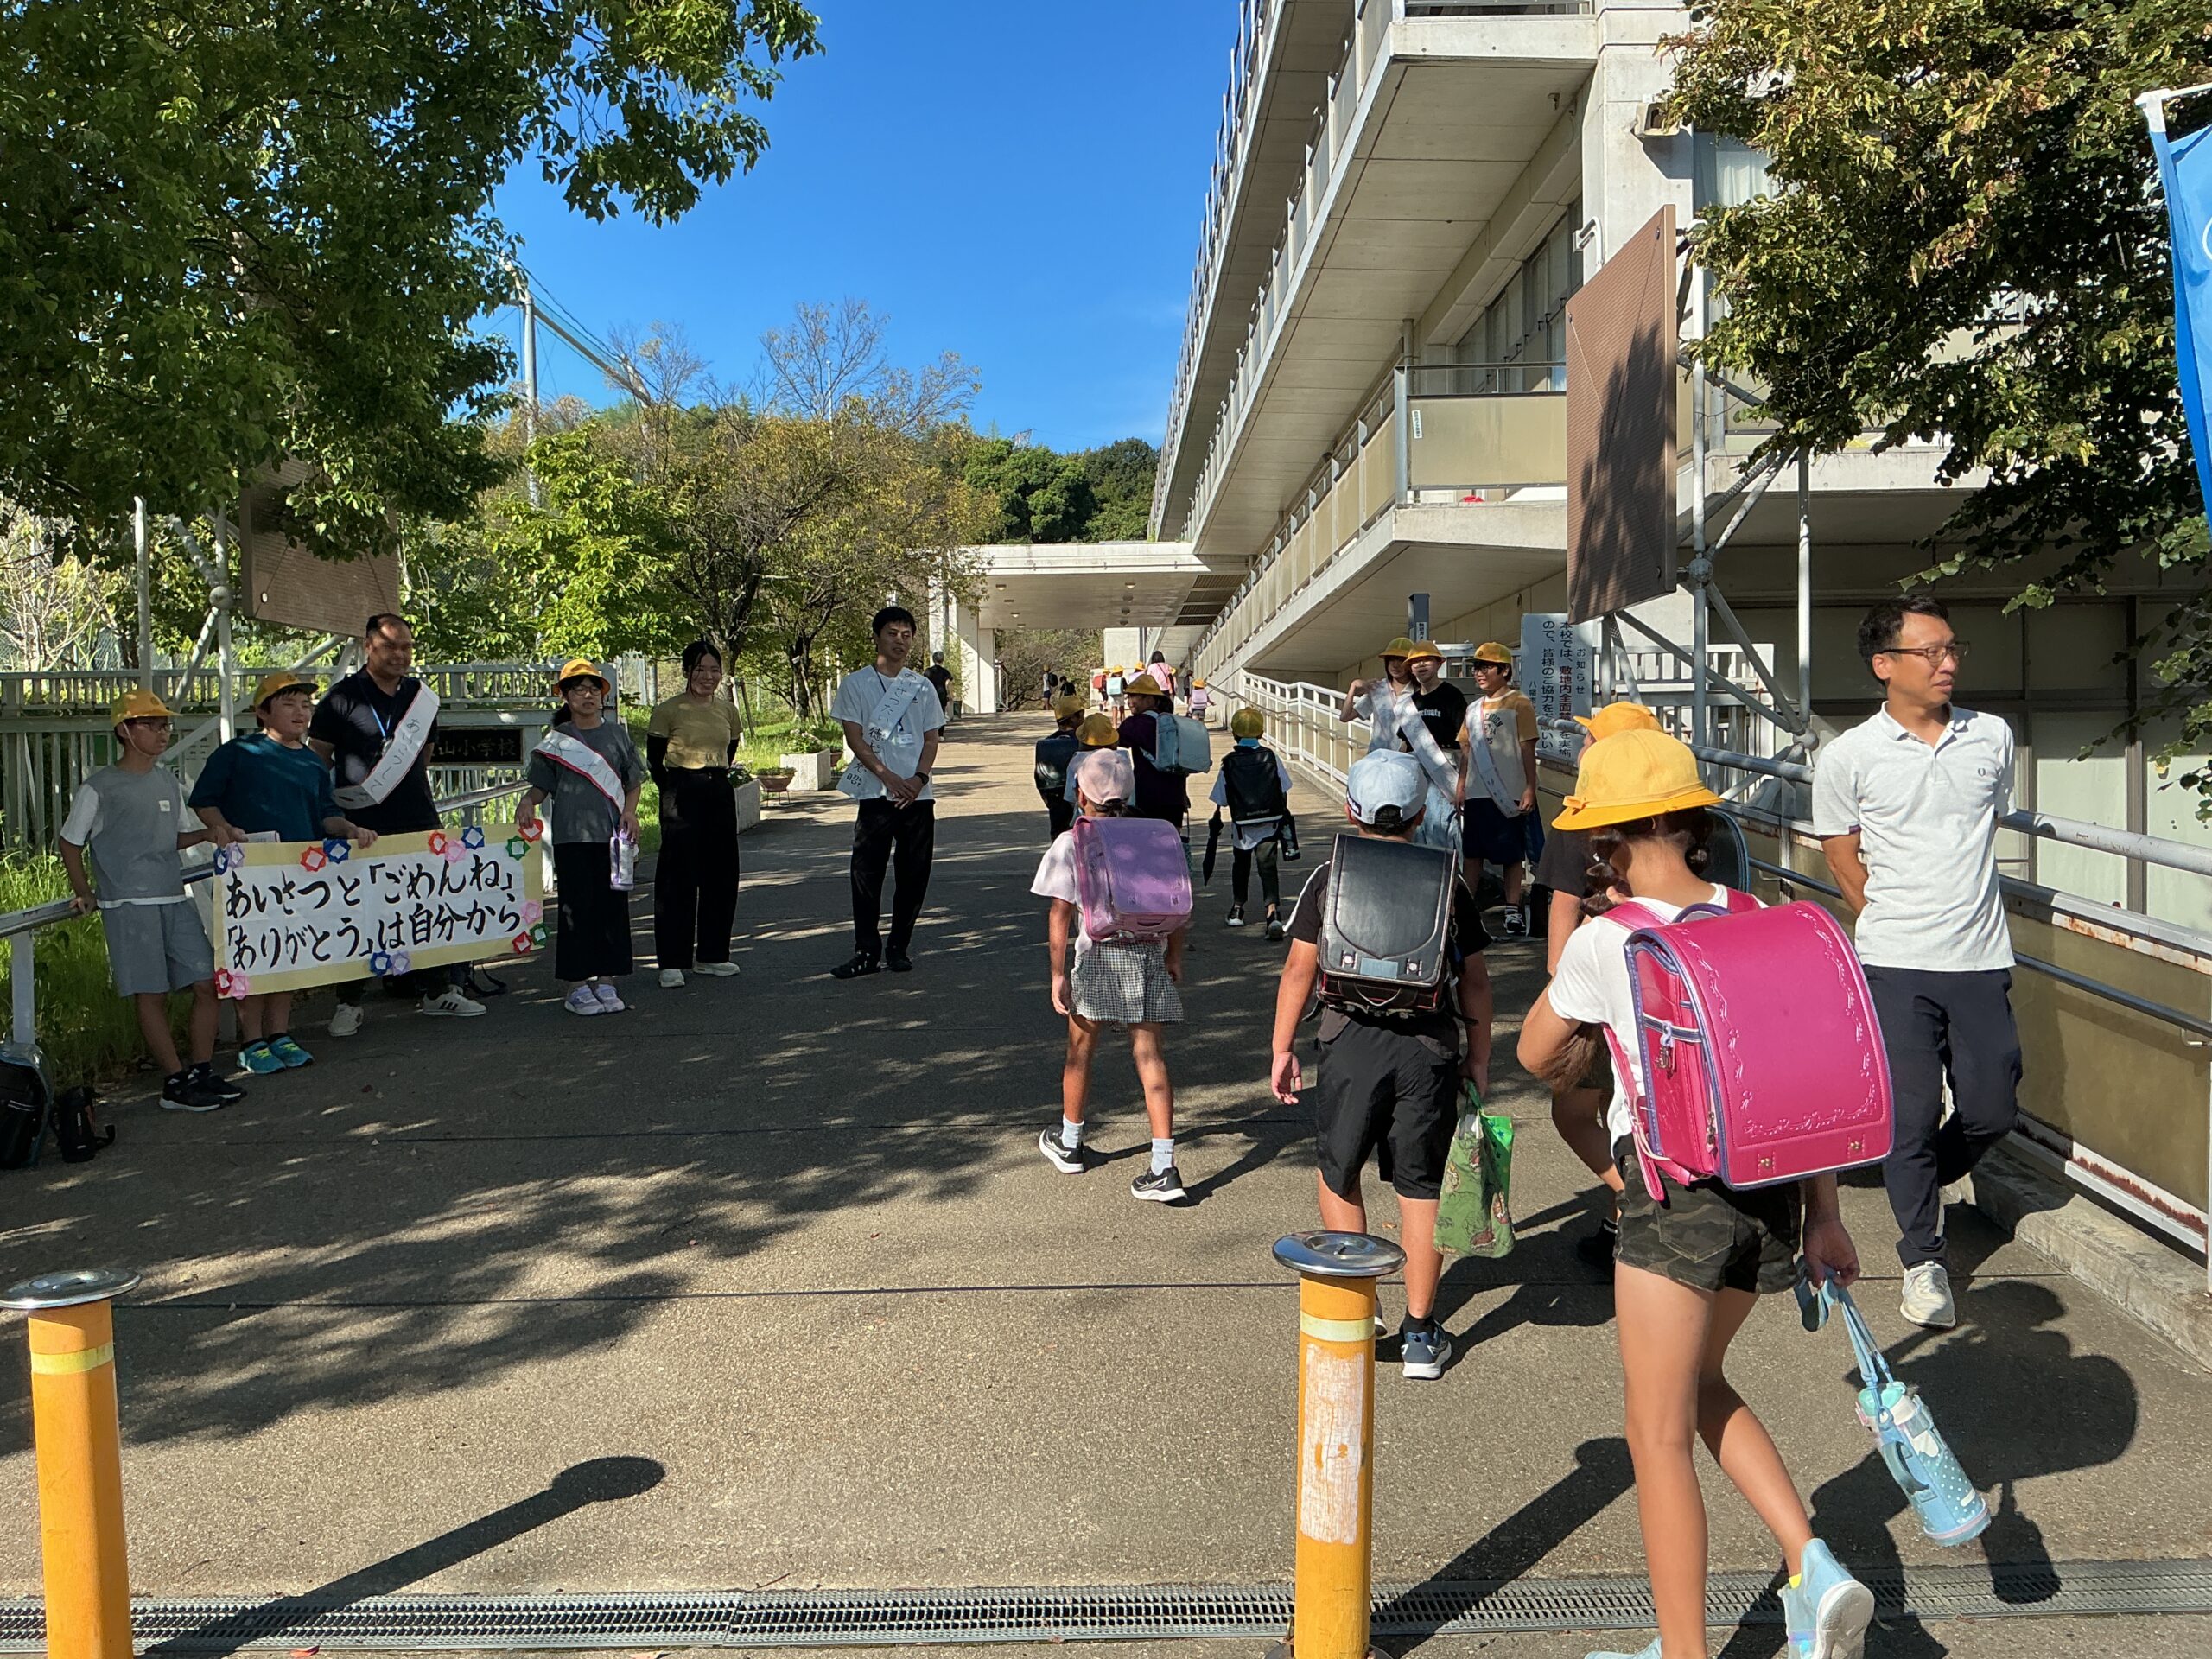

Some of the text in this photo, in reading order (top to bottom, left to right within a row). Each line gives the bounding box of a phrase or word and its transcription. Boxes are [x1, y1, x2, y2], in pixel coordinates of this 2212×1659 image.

[1558, 621, 1573, 758] 本校では、敷地内全面禁を実施
[1576, 648, 1586, 695] お知らせ
[226, 855, 513, 919] あいさつと「ごめんね」
[227, 893, 521, 971] 「ありがとう」は自分から
